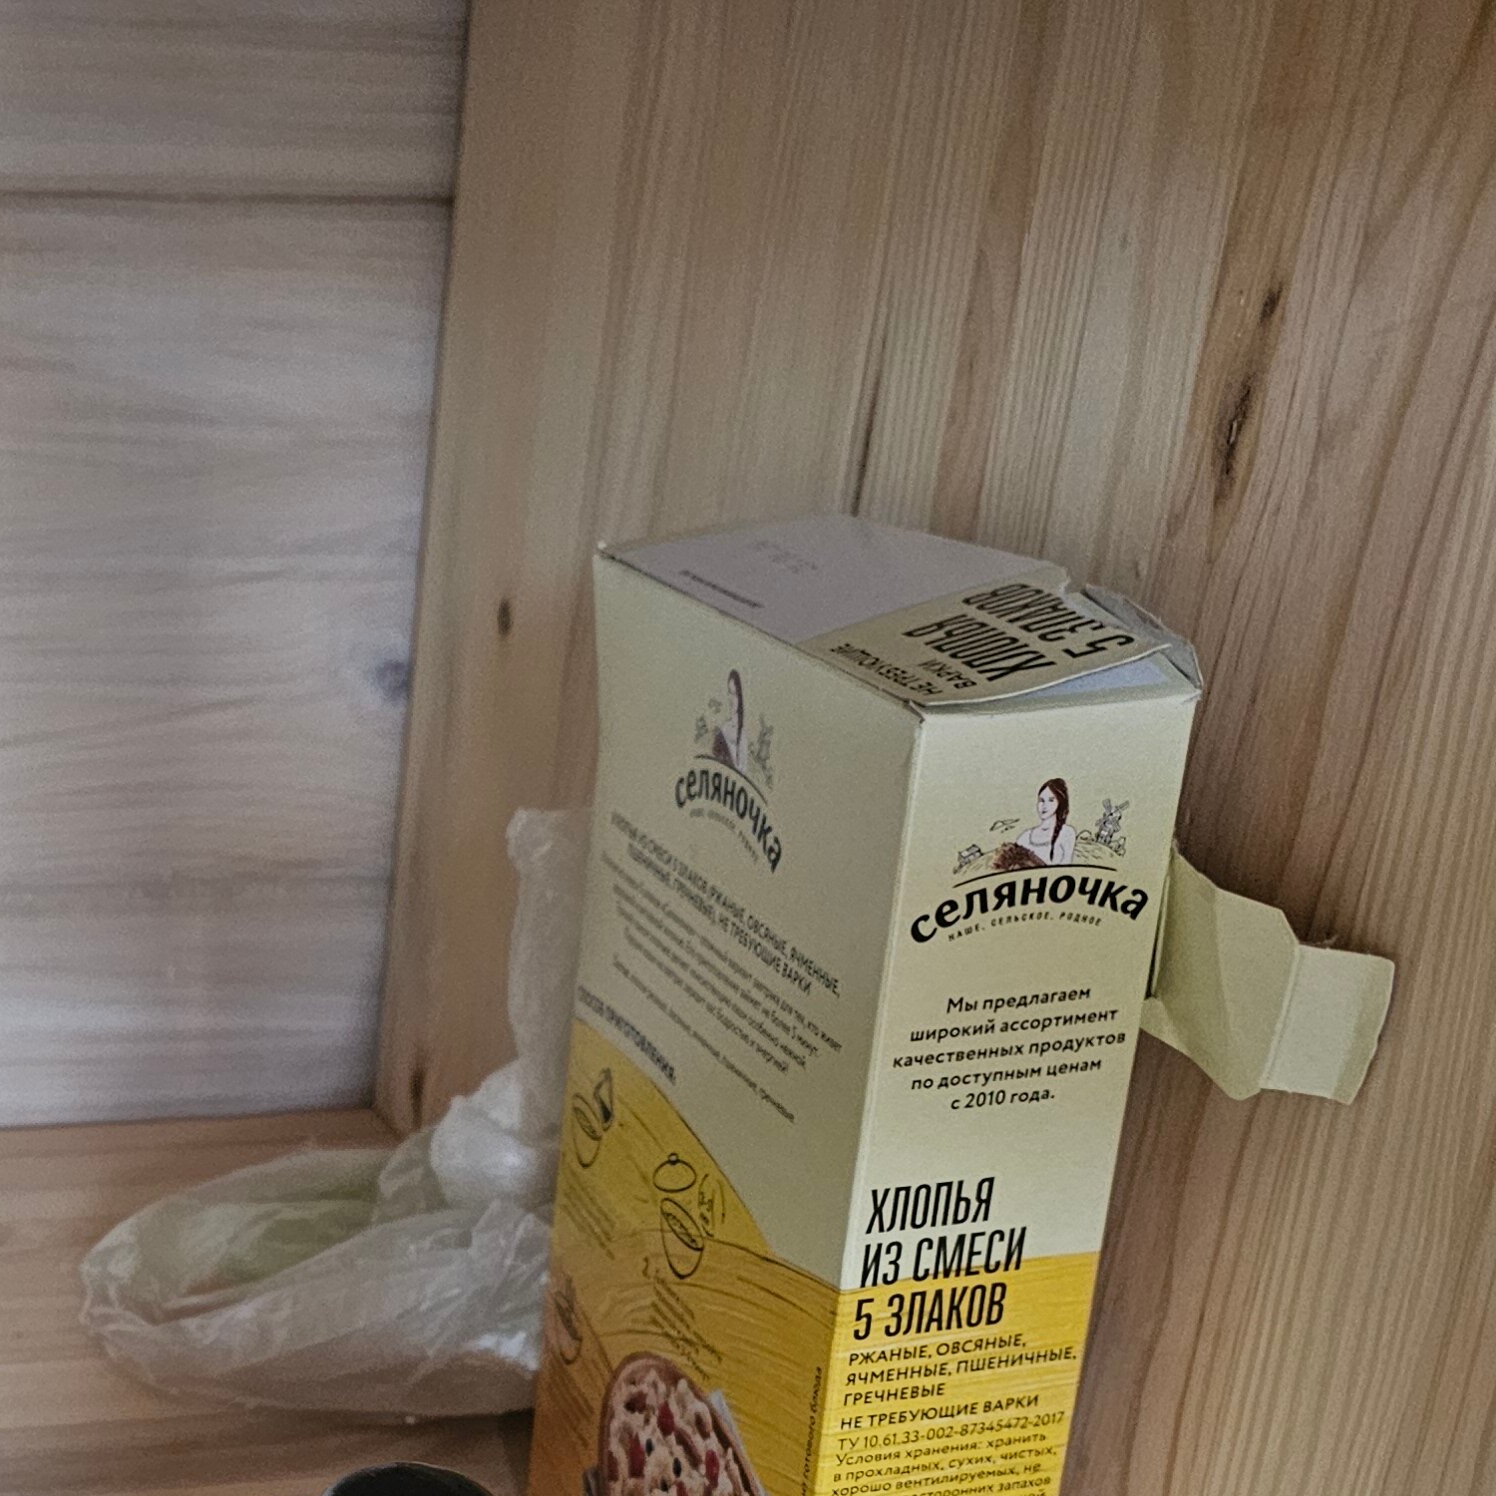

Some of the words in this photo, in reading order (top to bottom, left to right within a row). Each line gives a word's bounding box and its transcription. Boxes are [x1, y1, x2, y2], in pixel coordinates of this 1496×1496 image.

[962, 584, 1104, 643] ЗЛАКОВ
[901, 613, 1056, 681] ХЛОПЬЯ
[1063, 634, 1134, 659] 5
[831, 643, 922, 688] ТРЕБУЮЩИЕ
[917, 658, 978, 688] ВАРКИ
[1059, 912, 1102, 927] РОДНОЕ
[947, 998, 978, 1014] Мы
[982, 987, 1092, 1012] предлагаем
[910, 1019, 995, 1043] широкий
[999, 1008, 1119, 1033] ассортимент
[892, 1045, 1024, 1068] качественных
[1028, 1032, 1126, 1057] продуктов
[911, 1076, 934, 1090] по
[937, 1066, 1041, 1090] доступным
[1046, 1058, 1102, 1079] ценам
[950, 1098, 961, 1110] с
[964, 1089, 1005, 1109] 2010
[1010, 1087, 1055, 1104] года.
[865, 1176, 995, 1234] ХЛОПЬЯ
[860, 1241, 903, 1288] ИЗ
[912, 1226, 1027, 1282] СМЕСИ
[853, 1298, 875, 1341] 5
[885, 1282, 1008, 1337] ЗЛАКОВ
[846, 1362, 952, 1387] ЯЧМЕННЫЕ,
[956, 1346, 1077, 1374] ПШЕНИЧНЫЕ,
[849, 1344, 932, 1367] РЖАНЫЕ,
[936, 1333, 1026, 1357] ОВСЯНЫЕ,
[843, 1382, 946, 1406] ГРЕЧНЕВЫЕ
[841, 1416, 862, 1430] НЕ
[869, 1401, 978, 1427] ТРЕБУЮЩИЕ
[984, 1395, 1039, 1413] ВАРКИ
[836, 1450, 901, 1467] Условия
[904, 1441, 984, 1460] хранения:
[986, 1433, 1046, 1449] хранить
[838, 1438, 861, 1451] ТУ
[833, 1473, 842, 1482] в
[845, 1461, 945, 1482] прохладных,
[948, 1454, 997, 1472] сухих,
[999, 1446, 1057, 1462] чистых,
[895, 1466, 1020, 1490] вентилируемых,
[1023, 1463, 1042, 1474] не
[997, 1475, 1051, 1492] запахов
